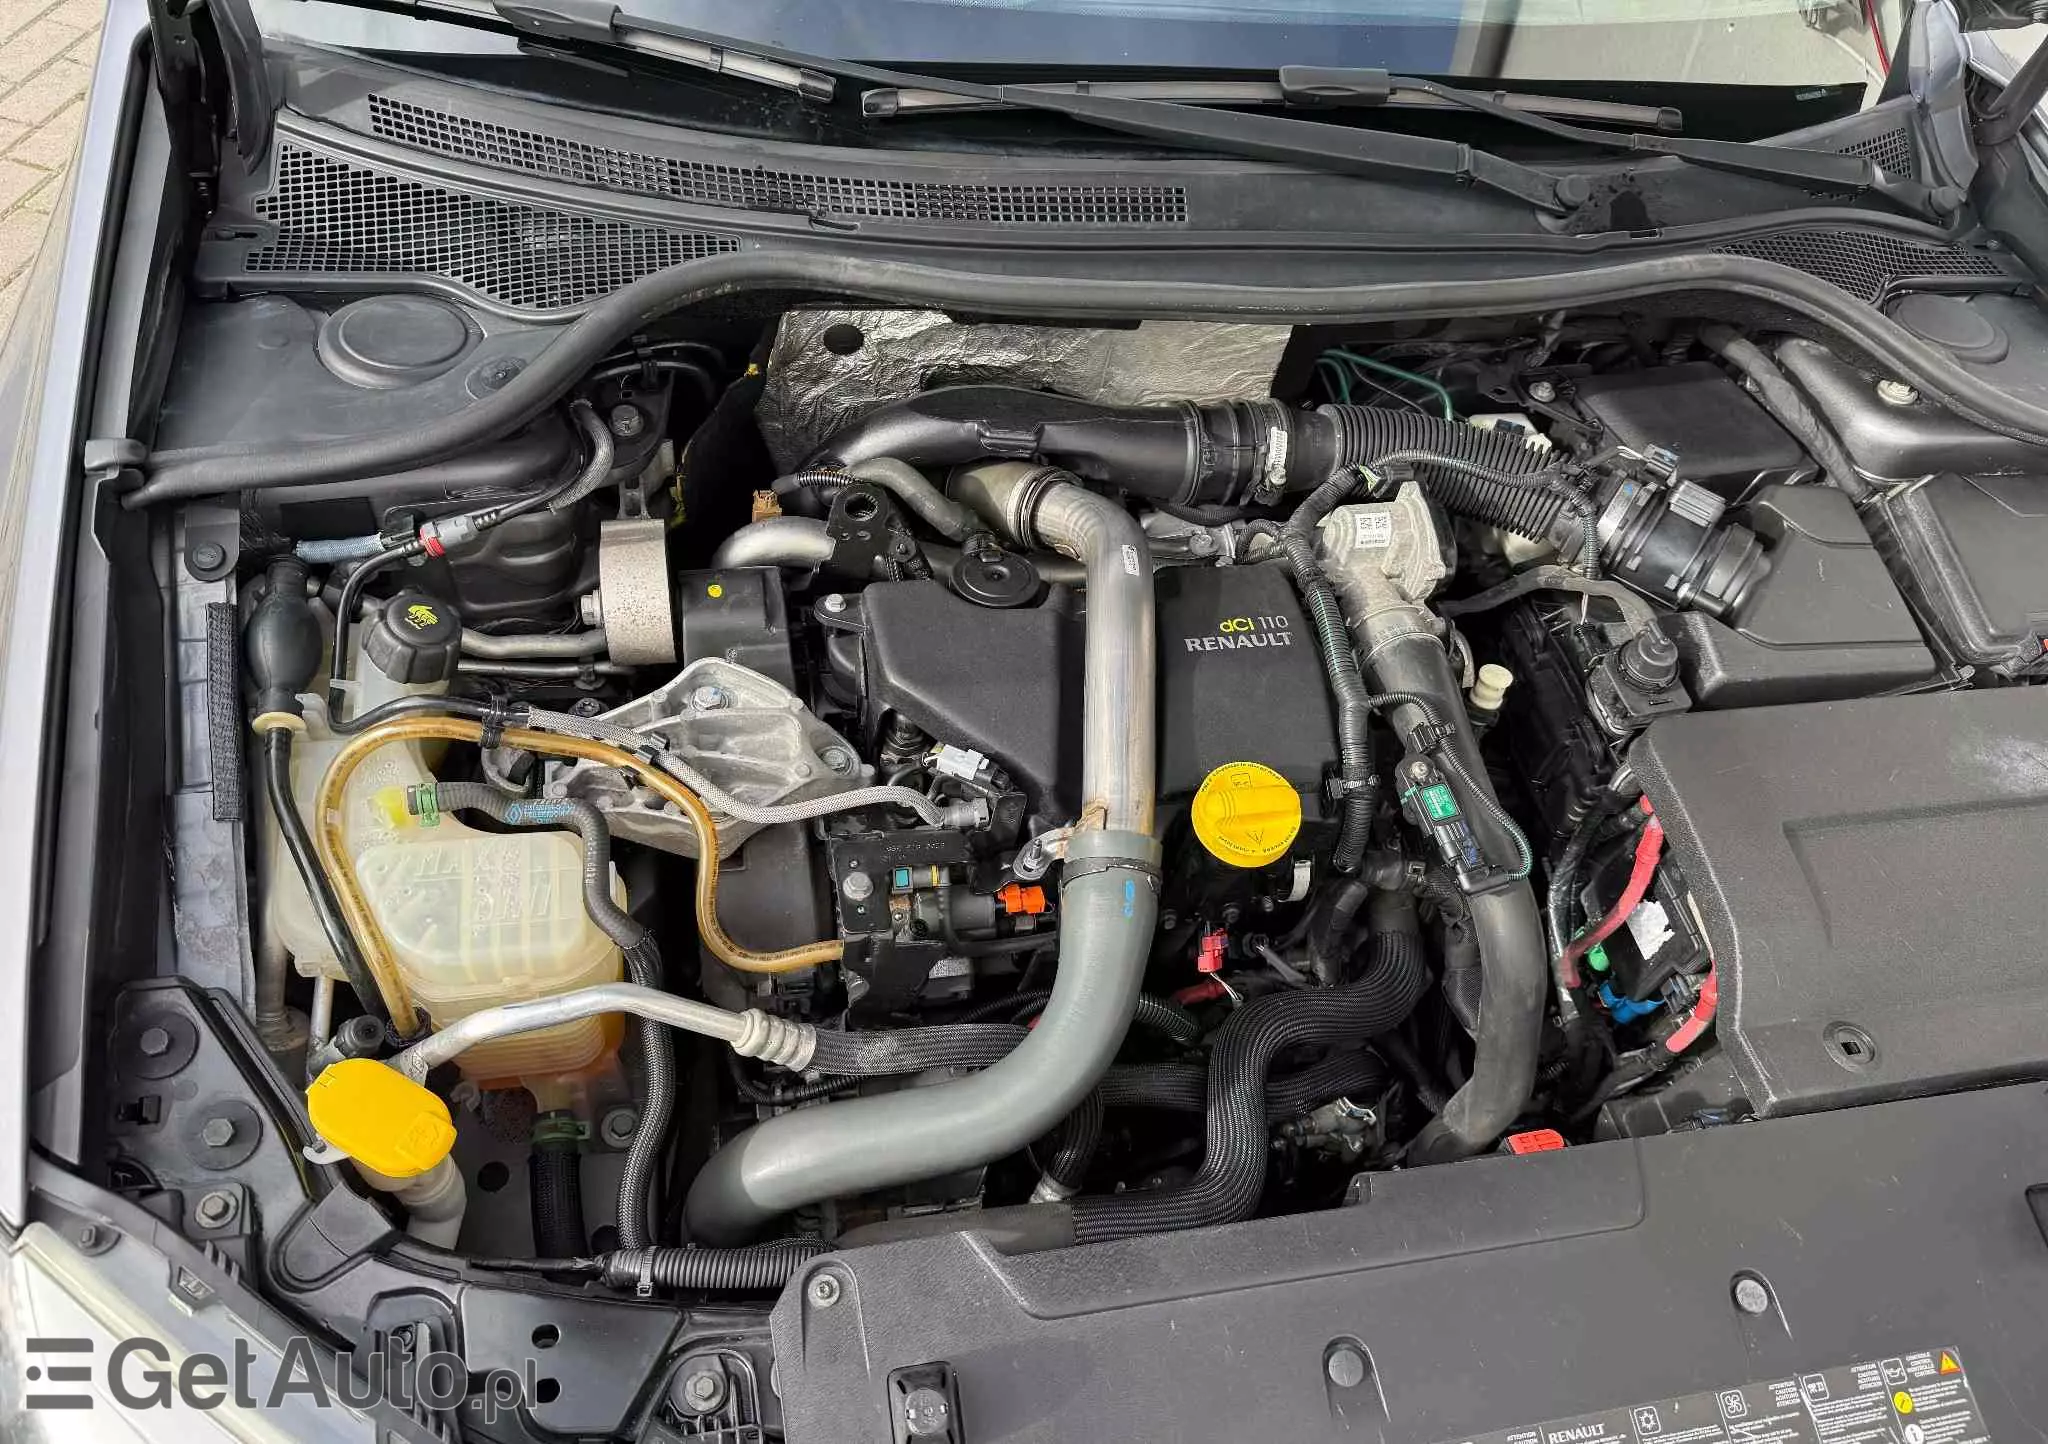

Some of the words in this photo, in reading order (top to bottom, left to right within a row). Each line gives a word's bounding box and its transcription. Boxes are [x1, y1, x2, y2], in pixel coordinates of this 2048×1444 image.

[1257, 615, 1289, 629] 110
[1184, 631, 1292, 652] RENAULT
[1548, 1423, 1605, 1444] RENAULT
